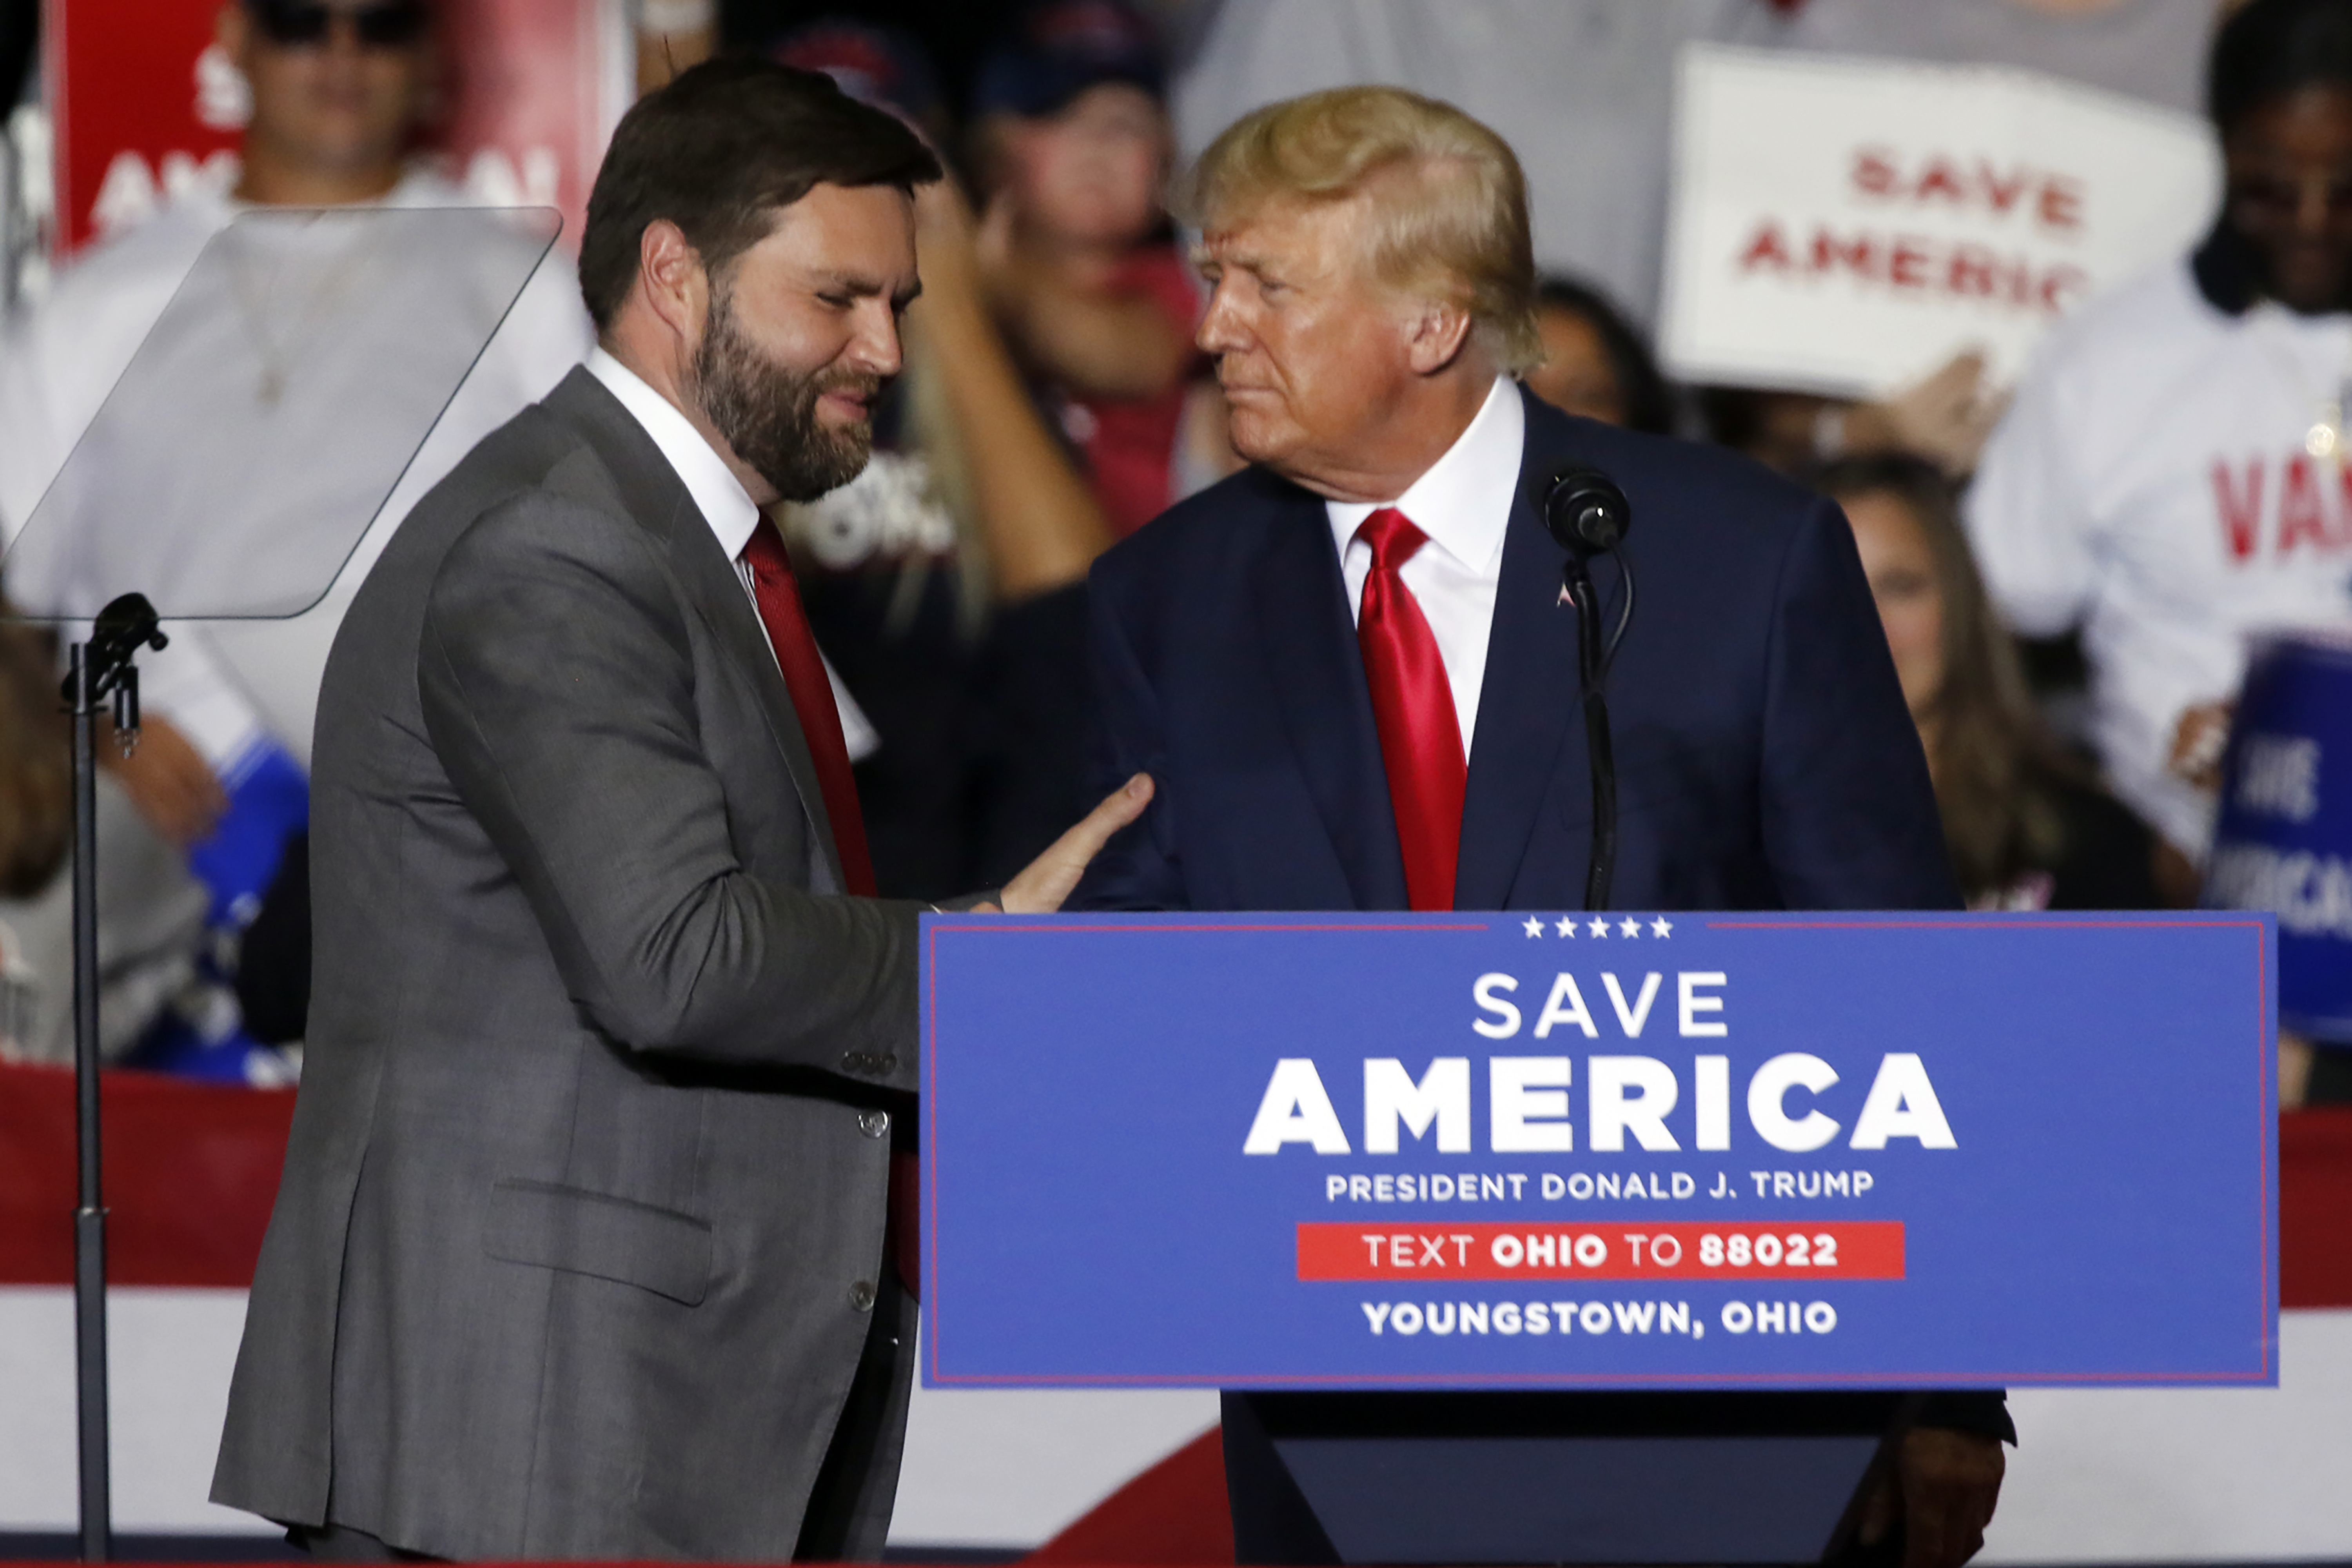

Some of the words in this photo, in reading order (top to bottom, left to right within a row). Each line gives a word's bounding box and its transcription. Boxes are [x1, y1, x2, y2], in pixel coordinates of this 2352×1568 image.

[1842, 146, 2087, 235] SAVE
[1472, 971, 1728, 1039] SAVE
[1243, 1052, 1958, 1155] AMERICA
[1326, 1173, 1528, 1201] PRESIDENT
[1541, 1172, 1695, 1200] DONALD
[1709, 1171, 1737, 1198] J.
[1750, 1170, 1873, 1198] TRUMP
[1361, 1234, 1474, 1267] TEXT
[1491, 1234, 1608, 1267] OHIO
[1624, 1234, 1682, 1267] TO
[1699, 1233, 1838, 1267] 88022
[1361, 1301, 1704, 1339] YOUNGSTOWN,
[1721, 1301, 1837, 1334] OHIO
